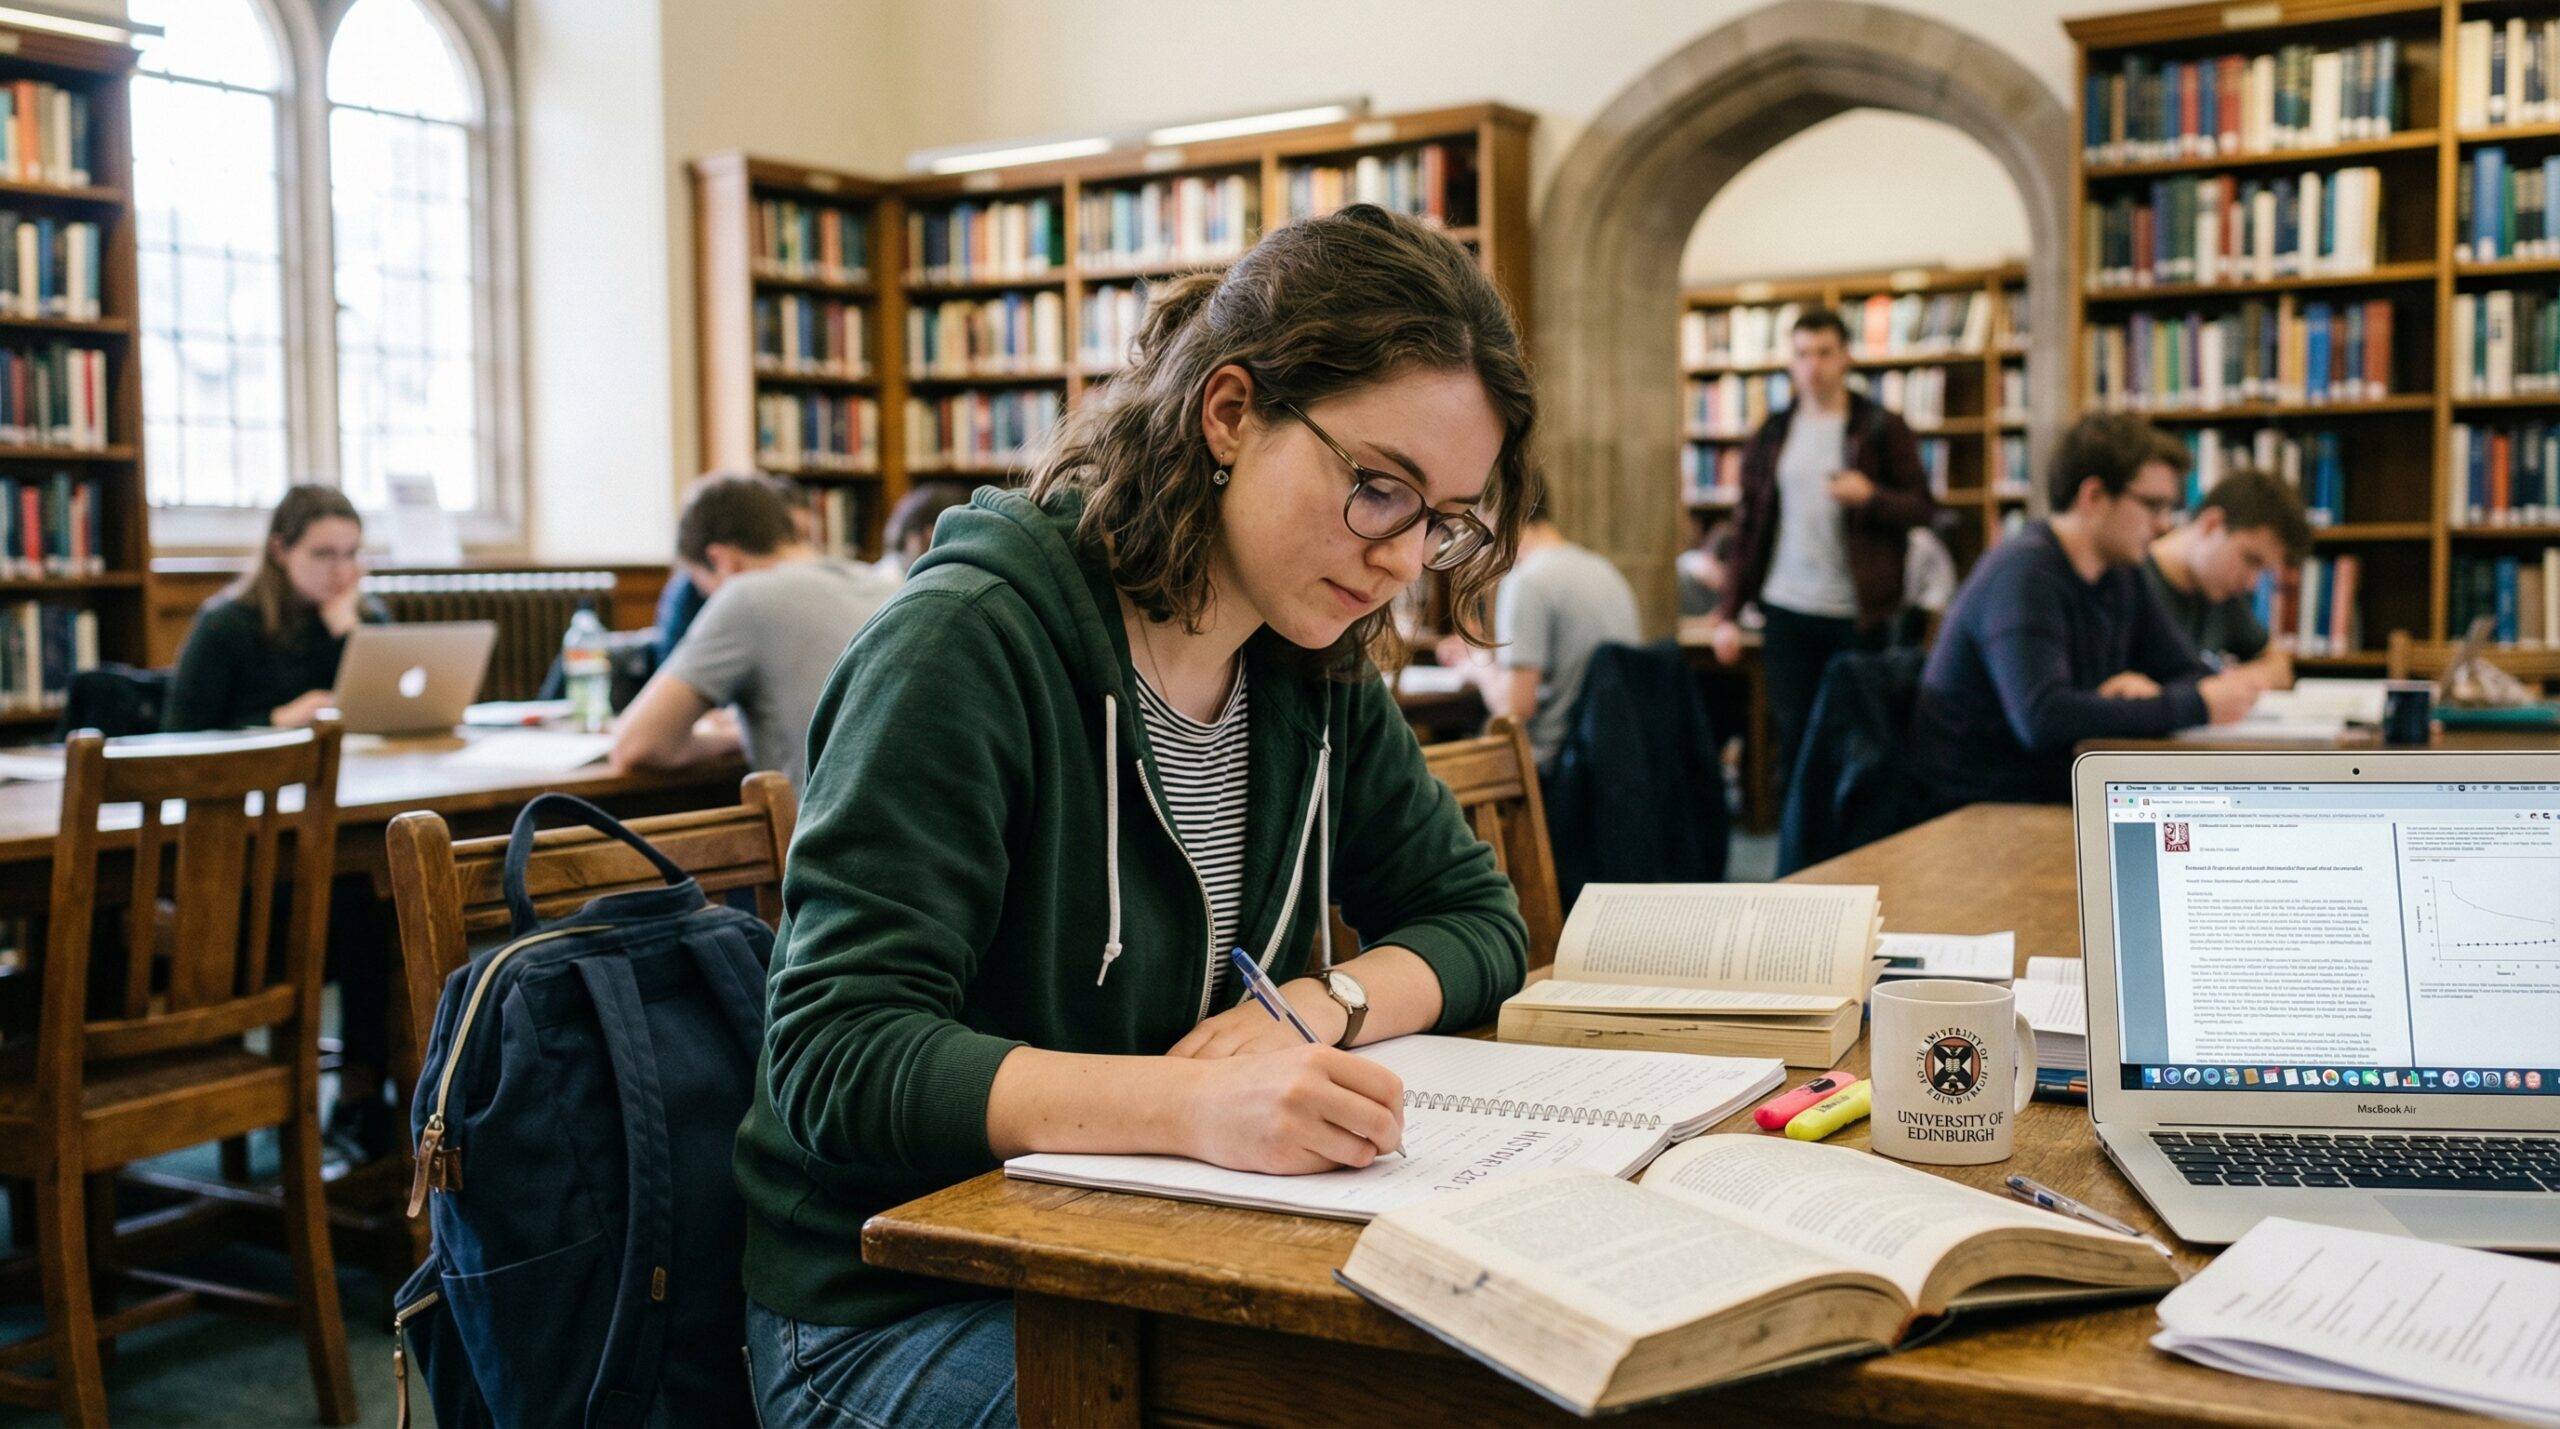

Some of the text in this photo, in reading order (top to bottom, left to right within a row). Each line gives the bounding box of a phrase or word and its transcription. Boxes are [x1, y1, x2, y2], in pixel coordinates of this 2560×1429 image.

[2403, 1105, 2417, 1114] Air
[1897, 1110, 2004, 1128] UNIVERSITY OF
[1907, 1126, 1995, 1143] EDINBURGH
